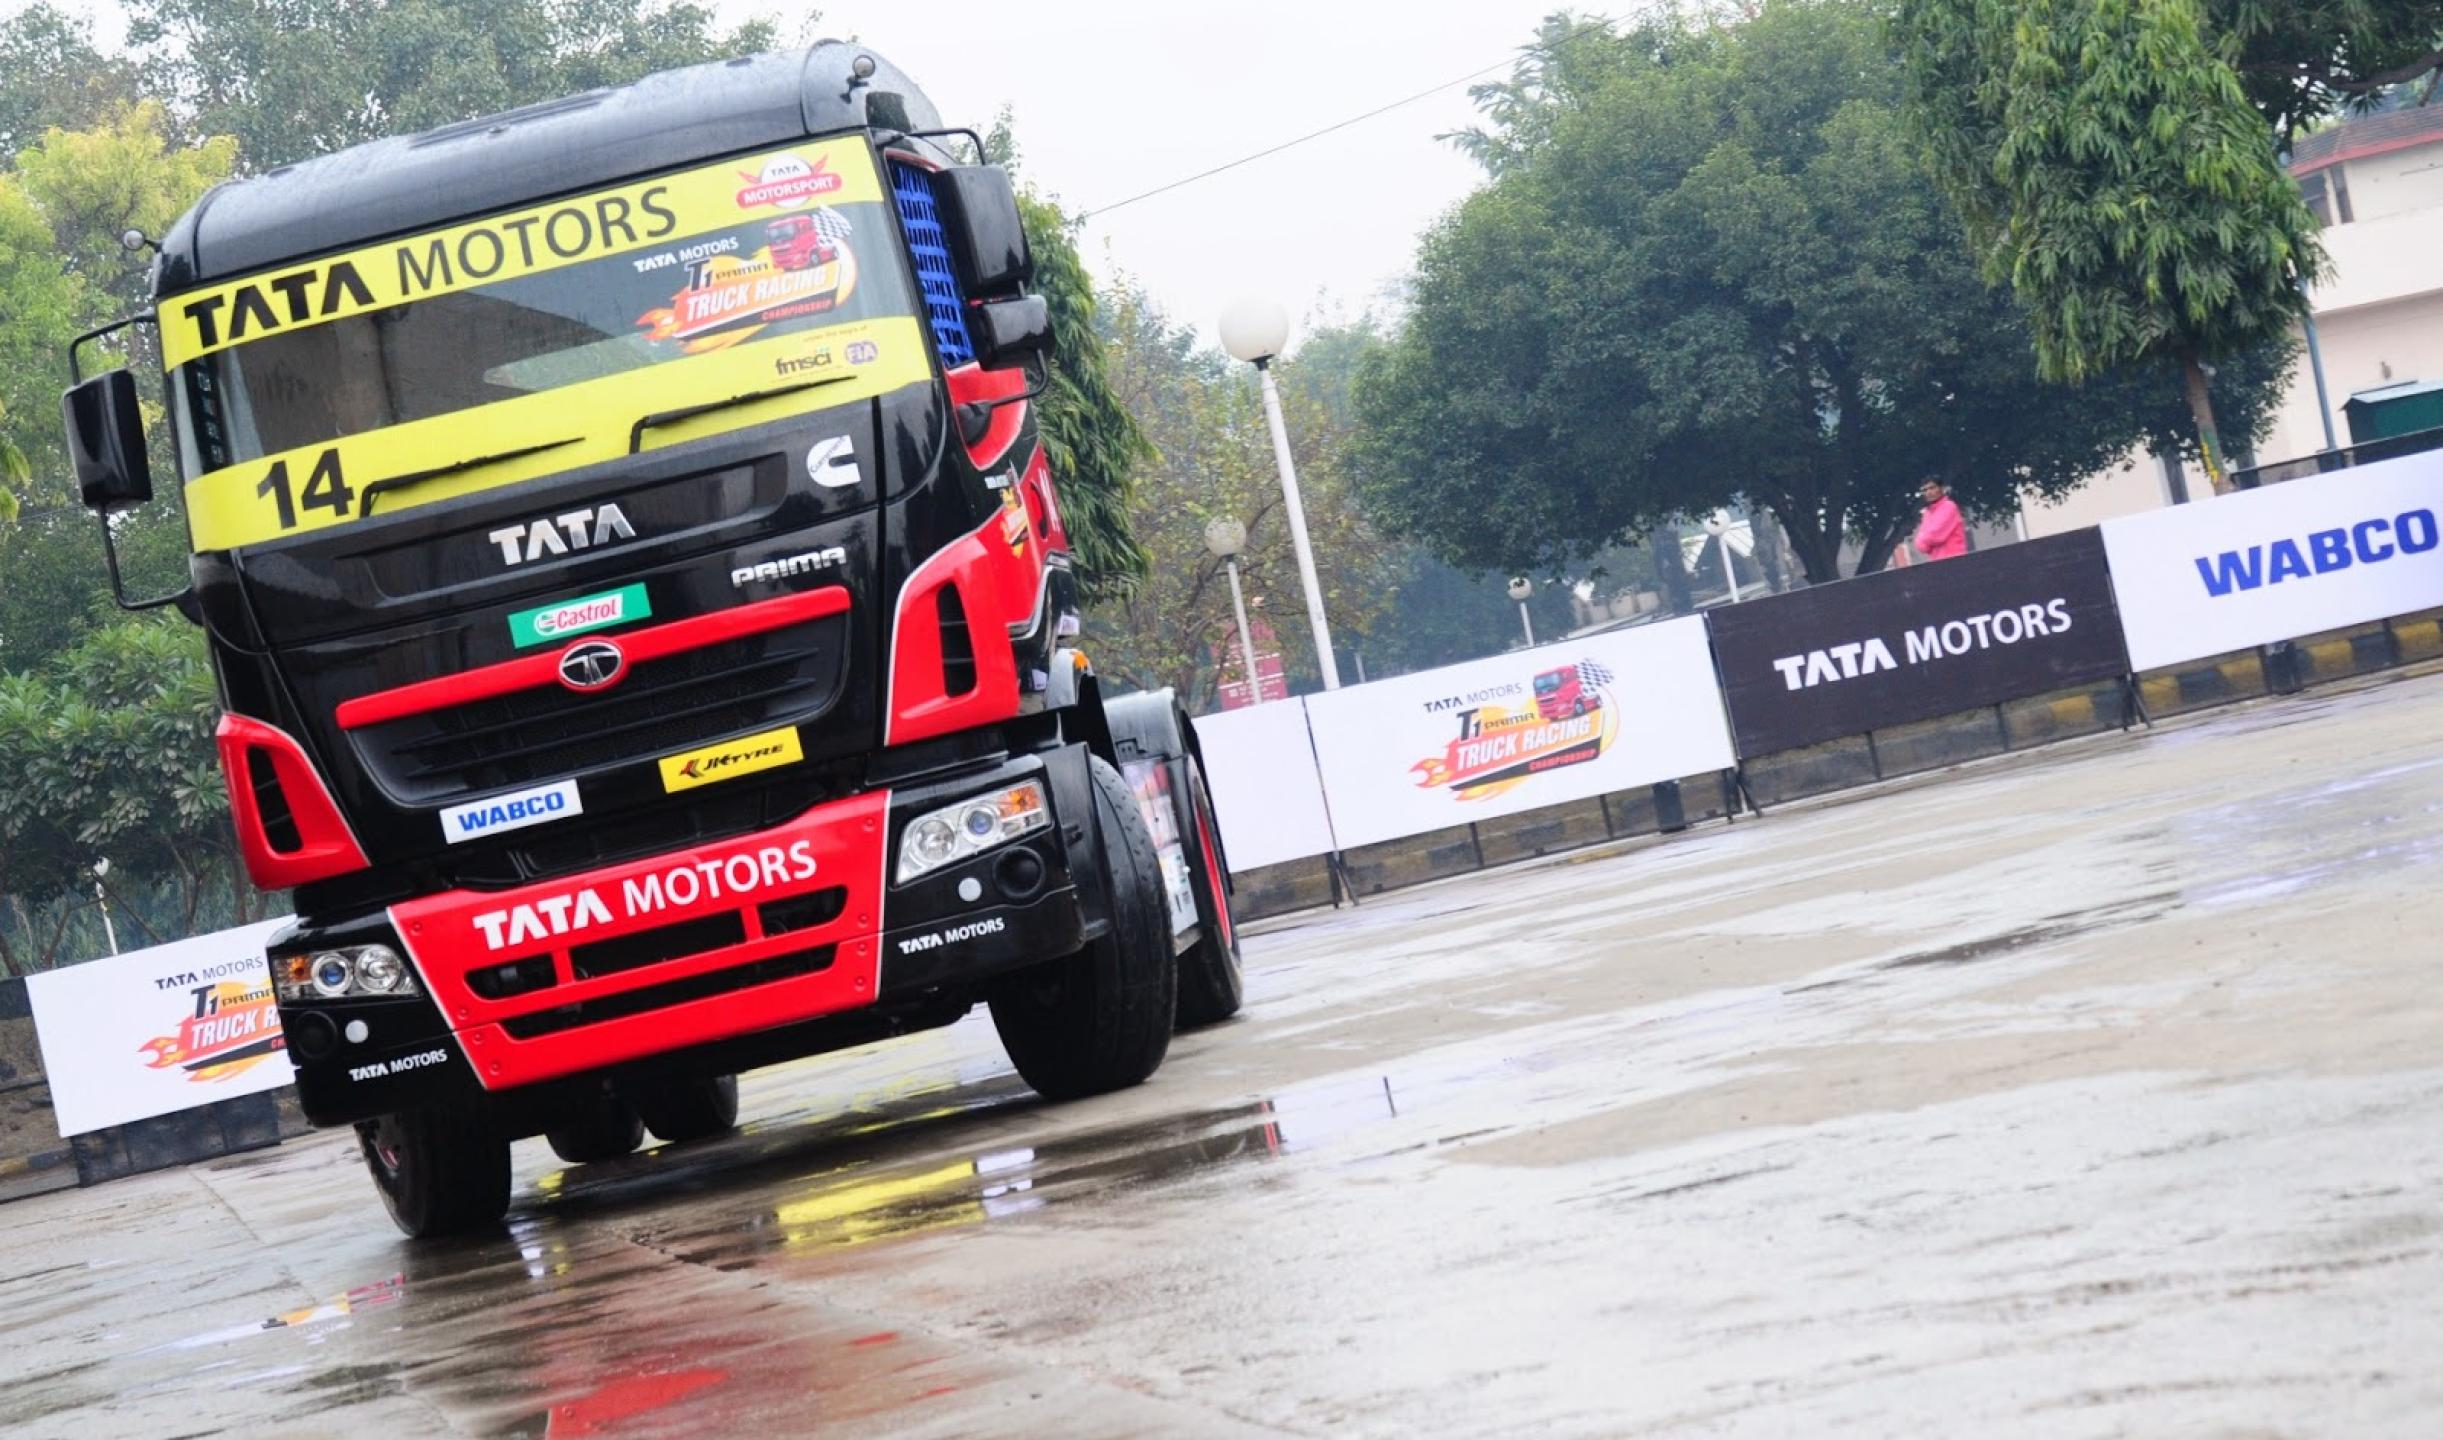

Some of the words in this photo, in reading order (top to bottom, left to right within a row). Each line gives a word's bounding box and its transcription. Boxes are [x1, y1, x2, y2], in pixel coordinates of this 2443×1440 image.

[743, 175, 834, 204] MOTORSPORT
[184, 261, 374, 349] TATA
[397, 187, 676, 295] MOTORS
[632, 252, 677, 273] TATA
[679, 236, 739, 262] MOTORS
[686, 286, 749, 321] TRUCK
[755, 268, 827, 303] RACING
[761, 299, 833, 321] CHAMPIONSHIP
[257, 449, 353, 530] 14
[489, 504, 636, 566] TATA
[2194, 507, 2439, 598] WABCO
[731, 546, 847, 588] PRIMA
[556, 598, 618, 629] Castrol
[1773, 637, 1898, 691] TATA
[1903, 598, 2073, 665] MOTORS
[1423, 696, 1463, 713] TATA
[1466, 683, 1523, 704] MOTORS
[1457, 733, 1519, 771] TRUCK
[1522, 716, 1591, 752] RACING
[458, 791, 565, 832] WABCO
[473, 889, 612, 950] TATA
[623, 840, 817, 916] MOTORS
[898, 932, 943, 954] TATA
[945, 917, 1005, 943] MOTORS
[154, 972, 199, 990] TATA
[202, 956, 264, 980] MOTORS
[191, 1008, 259, 1050] TRUCK
[349, 1065, 389, 1081] TATA
[391, 1049, 447, 1073] MOTORS
